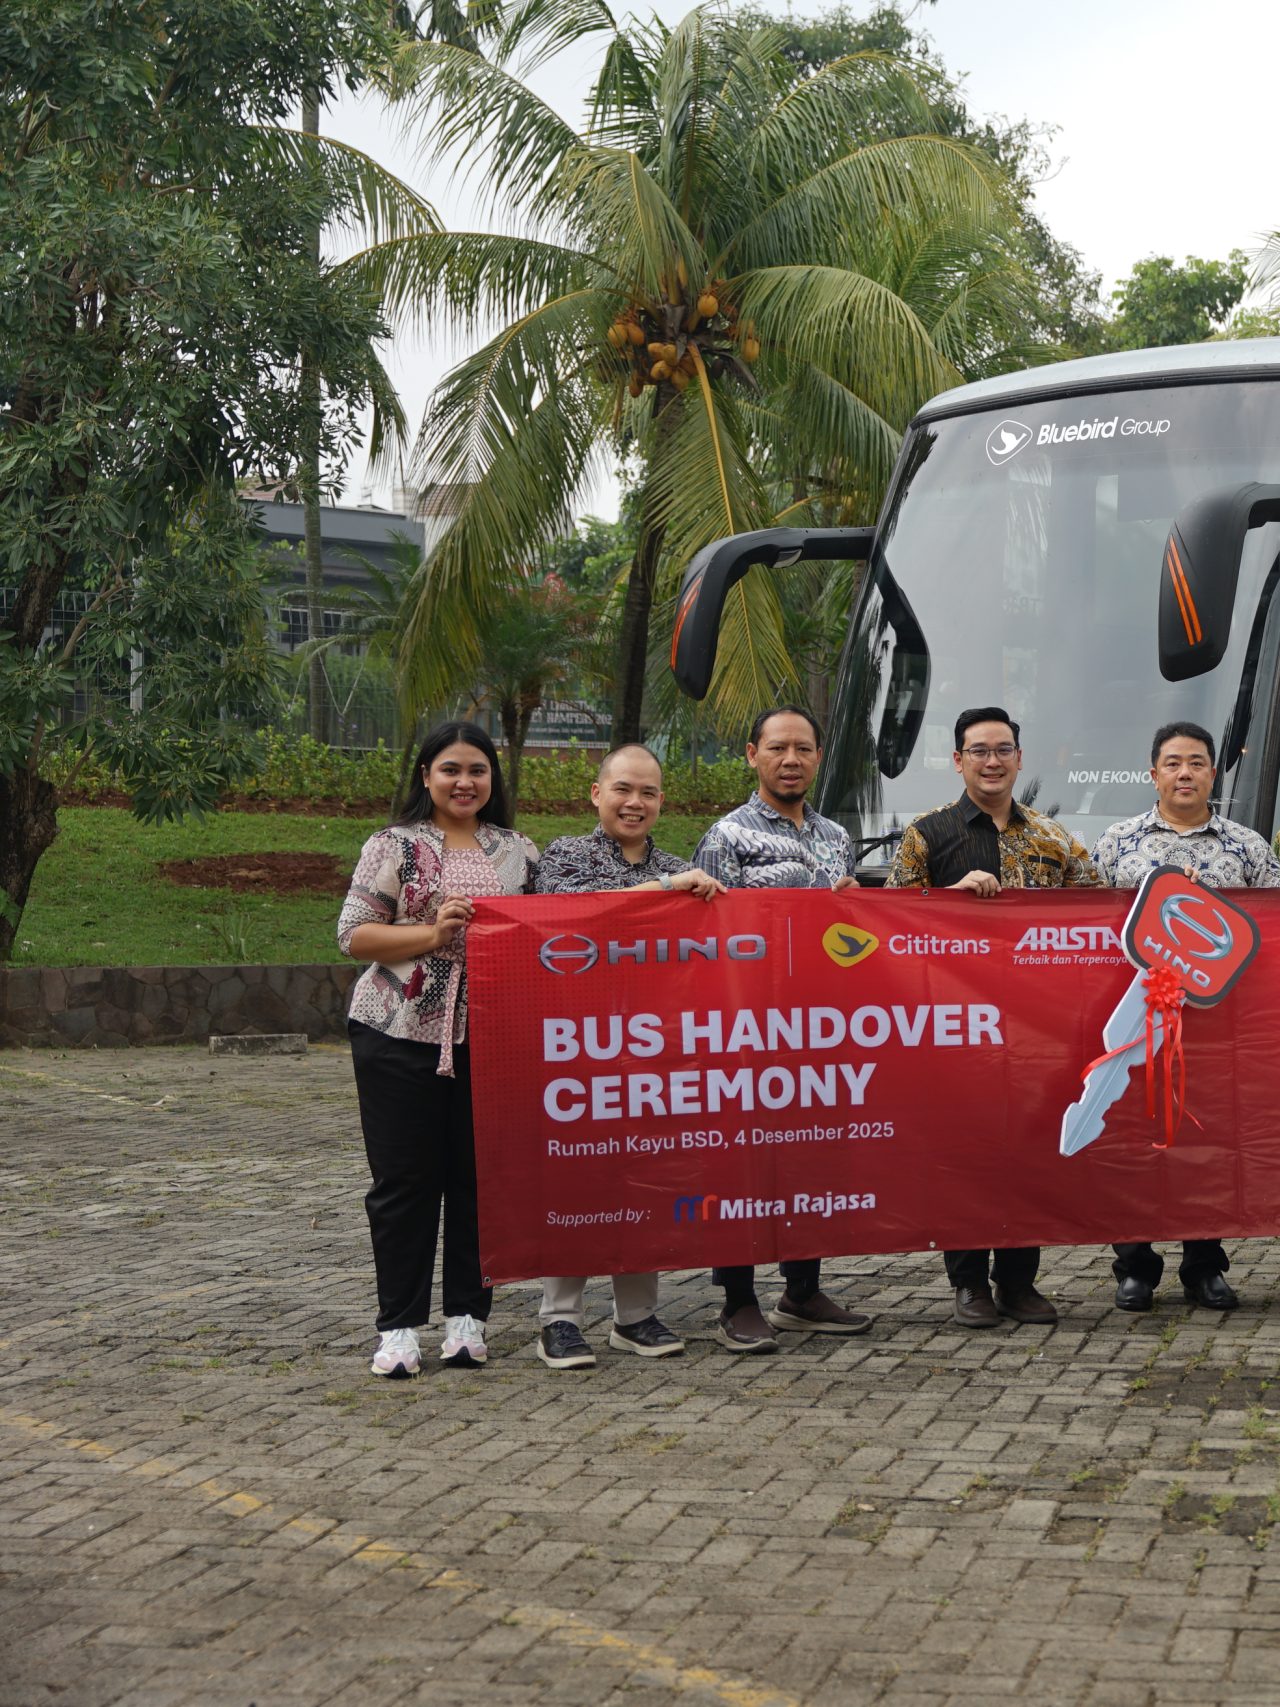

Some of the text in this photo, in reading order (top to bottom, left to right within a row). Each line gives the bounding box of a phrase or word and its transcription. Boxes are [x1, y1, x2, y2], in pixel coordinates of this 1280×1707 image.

[1036, 416, 1171, 446] Bluebird Group
[1068, 770, 1155, 784] NON EKONO
[607, 934, 767, 965] HINO
[888, 934, 991, 956] Cititrans
[1014, 926, 1122, 951] ARISTA
[1013, 954, 1050, 965] Terbaik
[1052, 954, 1071, 965] dan
[1143, 935, 1211, 988] HINO
[543, 1003, 1005, 1062] BUS HANDOVER
[543, 1062, 878, 1123] CEREMONY
[548, 1121, 895, 1157] Rumah Kayu BSD, 4 Desember 2025
[546, 1209, 623, 1228] Supported
[719, 1198, 786, 1220] Mitra
[793, 1191, 877, 1218] Rajasa
